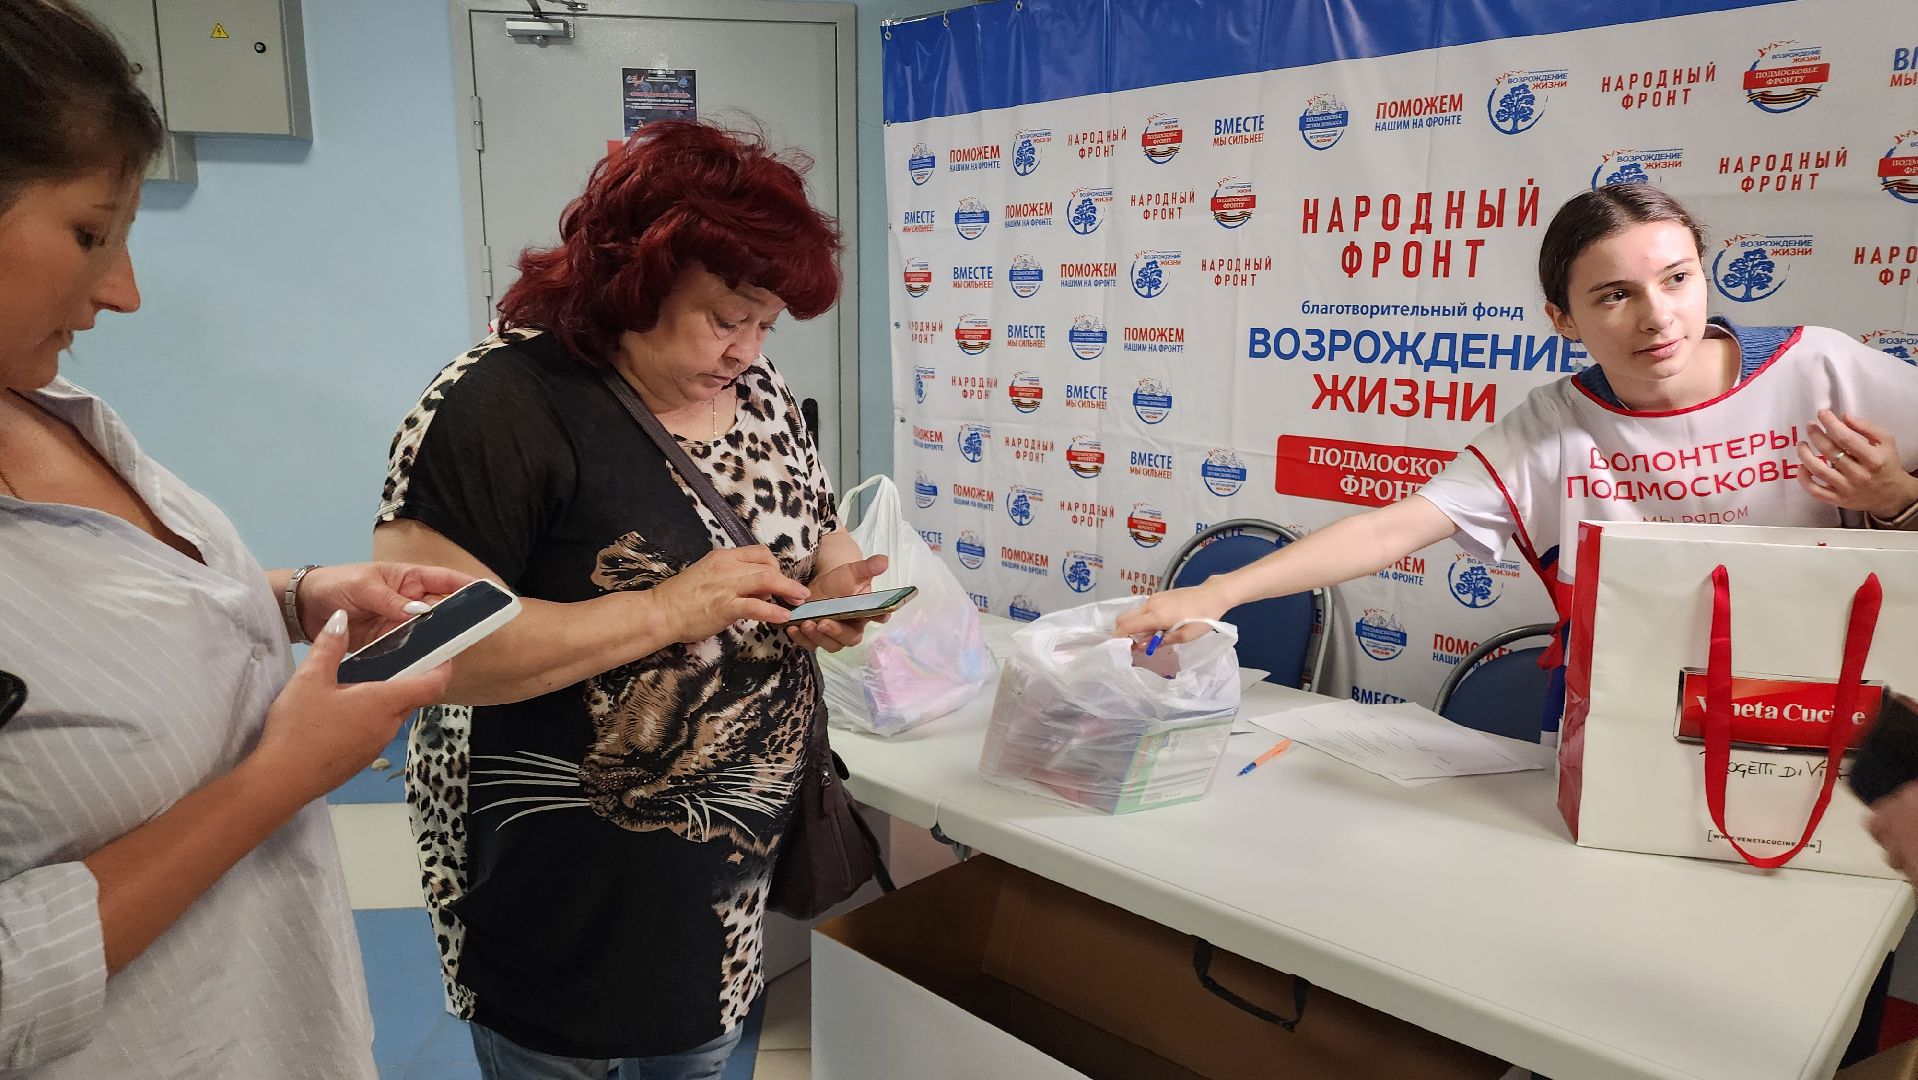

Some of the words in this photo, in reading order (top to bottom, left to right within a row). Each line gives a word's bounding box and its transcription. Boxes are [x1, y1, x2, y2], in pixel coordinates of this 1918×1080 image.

[1601, 61, 1716, 92] НАРОДНЫЙ
[1375, 93, 1463, 120] ПОМОЖЕМ
[1621, 88, 1692, 109] ФРОНТ
[1214, 114, 1265, 136] ВМЕСТЕ
[1375, 118, 1410, 132] НАШИМ
[1412, 117, 1424, 129] НА
[1425, 114, 1463, 128] ФРОНТЕ
[1067, 126, 1128, 146] НАРОДНЫЙ
[1213, 135, 1226, 146] МЫ
[1228, 132, 1264, 145] СИЛЬНЕЕ!
[950, 145, 1000, 163] ПОМОЖЕМ
[1078, 145, 1115, 159] ФРОНТ
[1617, 152, 1683, 162] ВОЗРОЖДЕНИЕ
[1718, 146, 1848, 174] НАРОДНЫЙ
[1645, 161, 1682, 169] ЖИЗНИ
[1740, 173, 1820, 193] ФРОНТ
[1130, 188, 1195, 207] НАРОДНЫЙ
[1302, 178, 1541, 234] НАРОДНЫЙ
[904, 210, 935, 225] ВМЕСТЕ
[1005, 202, 1052, 218] ПОМОЖЕМ
[1143, 207, 1183, 221] ФРОНТ
[1341, 239, 1485, 279] ФРОНТ
[1771, 248, 1812, 256] ЖИЗНИ
[1853, 246, 1918, 265] НАРО
[953, 266, 993, 280] ВМЕСТЕ
[1060, 262, 1117, 278] ПОМОЖЕМ
[1201, 256, 1272, 272] НАРОДНЫЙ
[1061, 279, 1082, 288] НАШИМ
[1083, 279, 1092, 287] НА
[1093, 279, 1116, 287] ФРОНТЕ
[1214, 273, 1257, 287] ФРОНТ
[1301, 300, 1467, 318] благотворительный
[1472, 302, 1524, 320] фонд
[1007, 324, 1045, 340] ВМЕСТЕ
[1124, 327, 1184, 343] ПОМОЖЕМ
[1124, 343, 1146, 352] НАШИМ
[1148, 344, 1157, 352] НА
[1158, 344, 1184, 353] ФРОНТЕ
[1249, 327, 1589, 374] ВОЗРОЖДЕНИЕ
[1066, 384, 1107, 400] ВМЕСТЕ
[1311, 373, 1497, 423] ЖИЗНИ
[1015, 450, 1046, 463] ФРОНТ
[1590, 426, 1797, 473] ВОЛОНТЕРЫ
[1130, 451, 1173, 470] ВМЕСТЕ
[1308, 445, 1457, 478] ПОДМОСКО
[953, 483, 994, 503] ПОМОЖЕМ
[1001, 546, 1048, 568] ПОМОЖЕМ
[1391, 573, 1424, 586] ФРОНТЕ
[1696, 695, 1778, 720] Vneta
